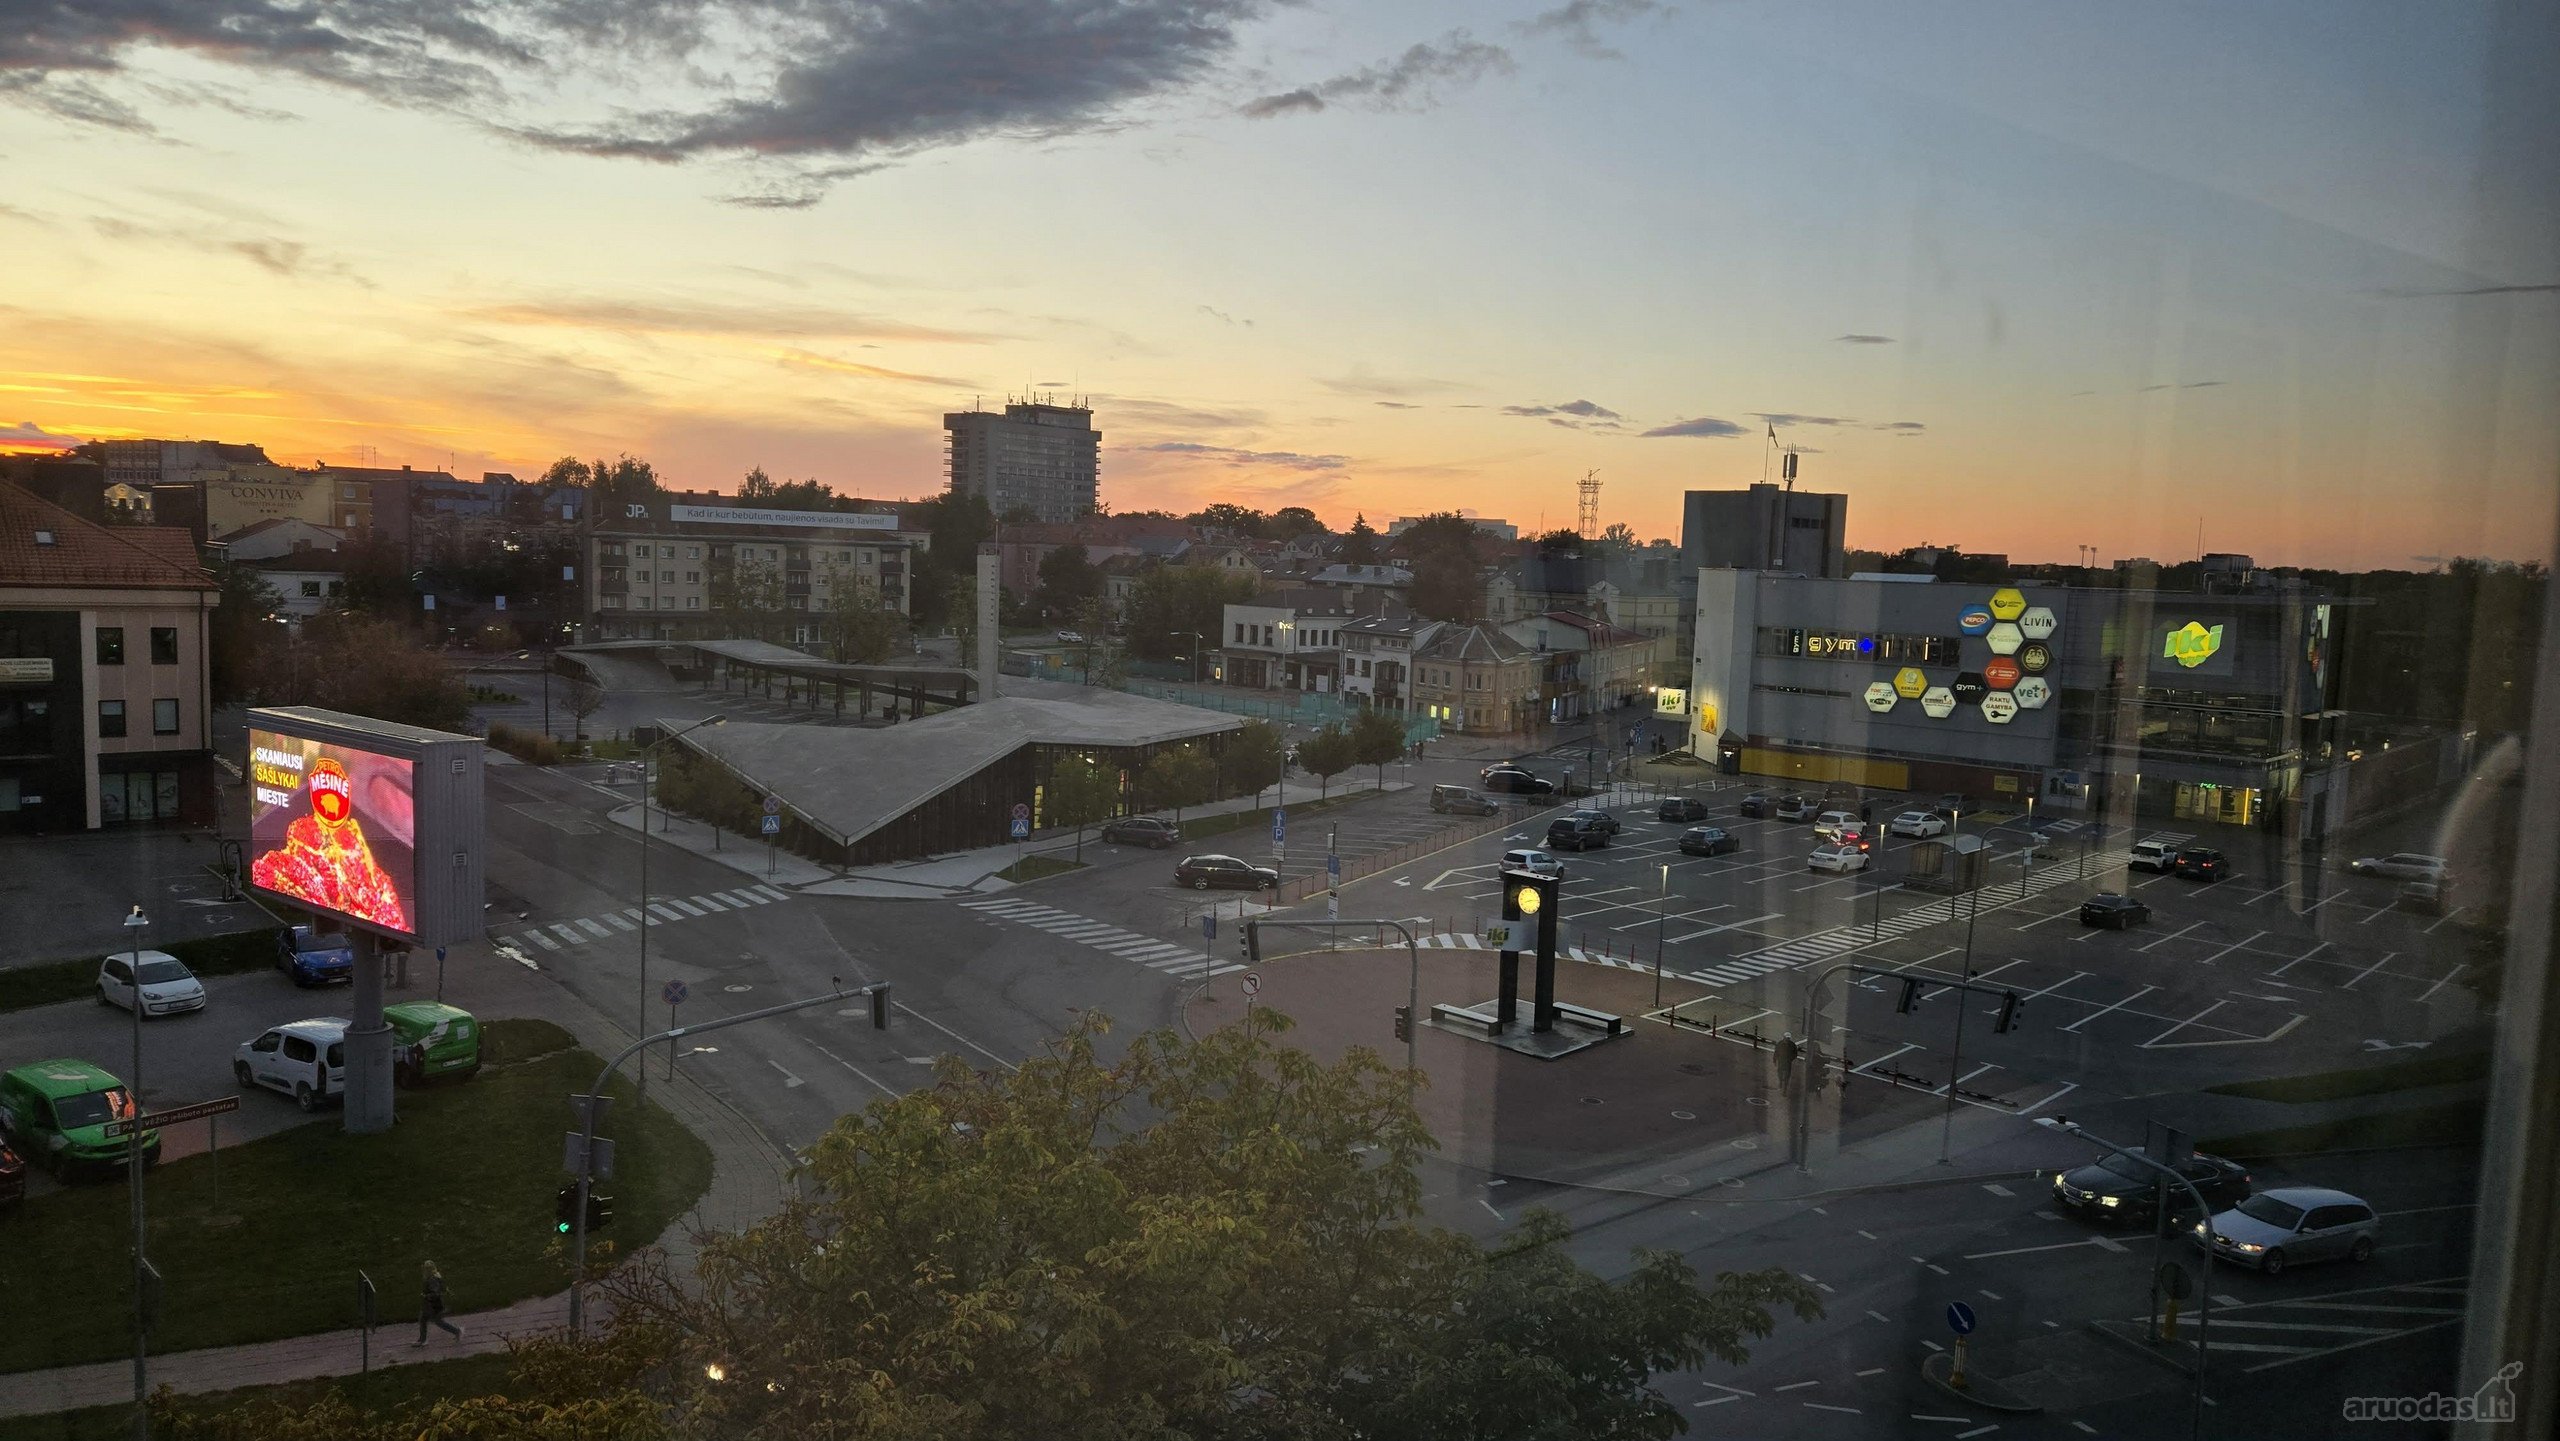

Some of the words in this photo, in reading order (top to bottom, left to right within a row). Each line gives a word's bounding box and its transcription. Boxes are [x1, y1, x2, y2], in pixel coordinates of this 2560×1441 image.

[231, 487, 304, 500] CONVIVA
[687, 508, 705, 519] Kad
[707, 510, 714, 519] ir
[716, 510, 730, 520] kur
[775, 514, 816, 525] naujienos
[817, 516, 844, 525] visada
[845, 517, 855, 525] su
[2164, 625, 2223, 657] iki
[1662, 694, 1681, 706] iki
[256, 747, 303, 770] SKANIAUSI
[256, 764, 298, 790] ŠAŠLYKAI
[256, 787, 289, 808] MIESTE
[1276, 829, 1282, 839] P
